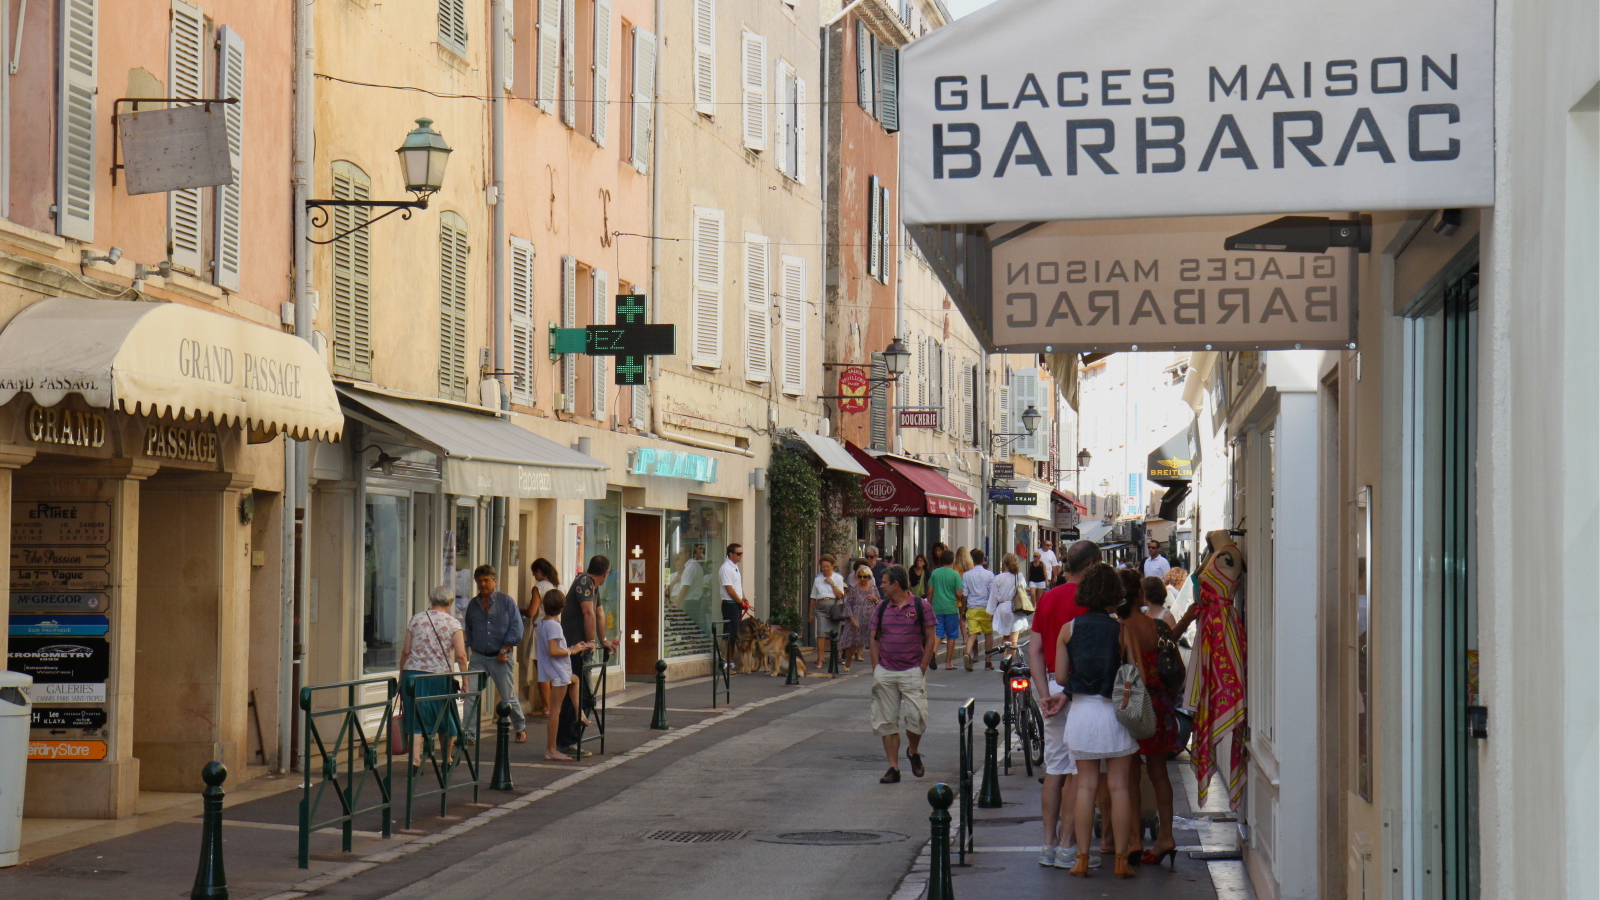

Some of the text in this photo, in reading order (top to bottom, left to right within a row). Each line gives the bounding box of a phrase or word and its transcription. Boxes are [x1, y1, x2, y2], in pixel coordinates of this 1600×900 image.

[934, 53, 1459, 112] GLACES MAISON
[932, 103, 1462, 179] BARBARAC
[179, 337, 302, 399] GRAND PASSAGE
[901, 413, 936, 426] BOUCHERIE
[29, 405, 218, 463] GRAND PASSAGE
[518, 465, 552, 497] Paparazzi
[868, 484, 893, 496] GHIGO
[848, 504, 884, 514] oucherie
[889, 503, 921, 513] Traiteur
[23, 550, 81, 564] The Passion
[18, 570, 31, 579] La
[51, 570, 83, 582] Vague
[46, 684, 94, 695] GALERIES
[28, 742, 90, 759] erdryStore
